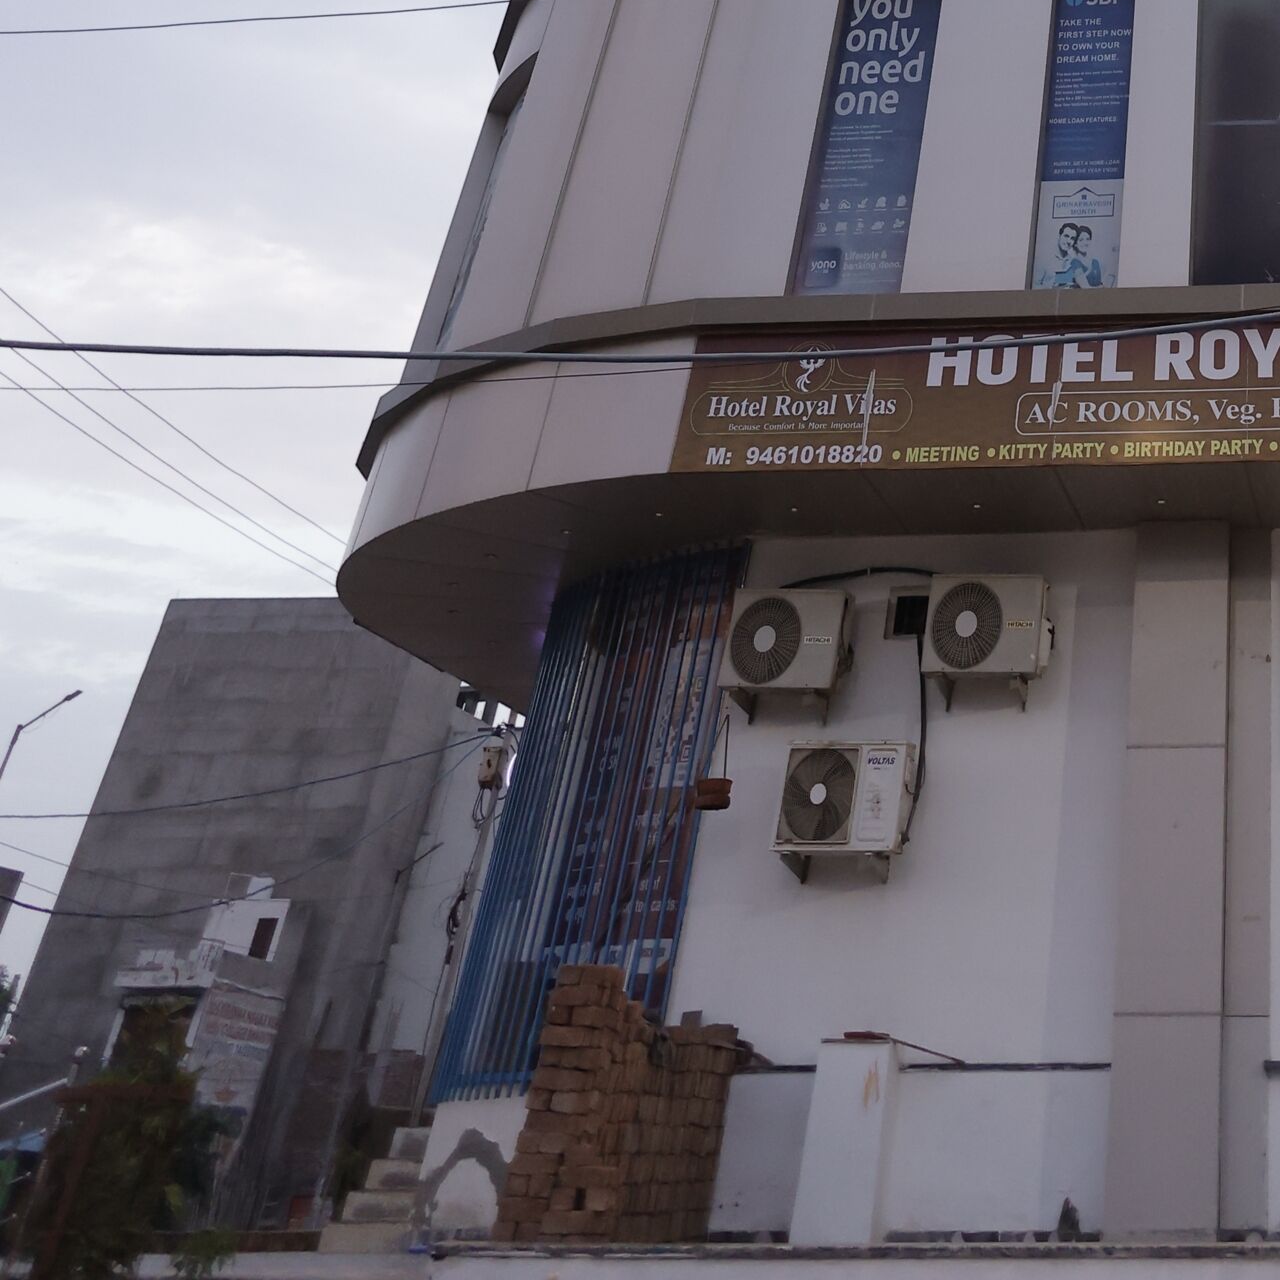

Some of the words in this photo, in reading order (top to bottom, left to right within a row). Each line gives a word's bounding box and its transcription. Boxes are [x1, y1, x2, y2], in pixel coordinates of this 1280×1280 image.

[1060, 18, 1082, 27] TAKE
[1085, 17, 1101, 26] THE
[846, 21, 920, 58] only
[1058, 31, 1084, 39] FIRST
[1086, 30, 1109, 38] STEP
[1110, 28, 1132, 37] NOW
[1058, 43, 1069, 51] TO
[1072, 42, 1093, 51] OWN
[1095, 41, 1120, 50] YOUR
[1056, 54, 1088, 64] DREAM
[1090, 53, 1120, 63] HOME.
[838, 51, 926, 86] need
[835, 88, 900, 116] one
[1067, 117, 1085, 125] LOAN
[844, 250, 879, 263] Lifestyle
[810, 258, 837, 274] yono
[925, 333, 1134, 387] HOTEL
[707, 396, 771, 417] Hotel
[774, 395, 836, 422] Royal
[1076, 398, 1199, 426] ROOMS,
[1210, 398, 1262, 425] Veg.
[728, 422, 762, 432] Because
[763, 421, 795, 432] Comfort
[798, 422, 806, 430] Is
[808, 421, 827, 430] More
[706, 446, 733, 465] M:
[745, 444, 883, 465] 9461018820
[905, 445, 980, 463] MEETING
[999, 443, 1047, 460] KITTY
[1052, 442, 1104, 459] PARTY
[1123, 440, 1206, 458] BIRTHDAY
[1210, 438, 1263, 456] PARTY
[867, 757, 896, 765] VOLTAS
